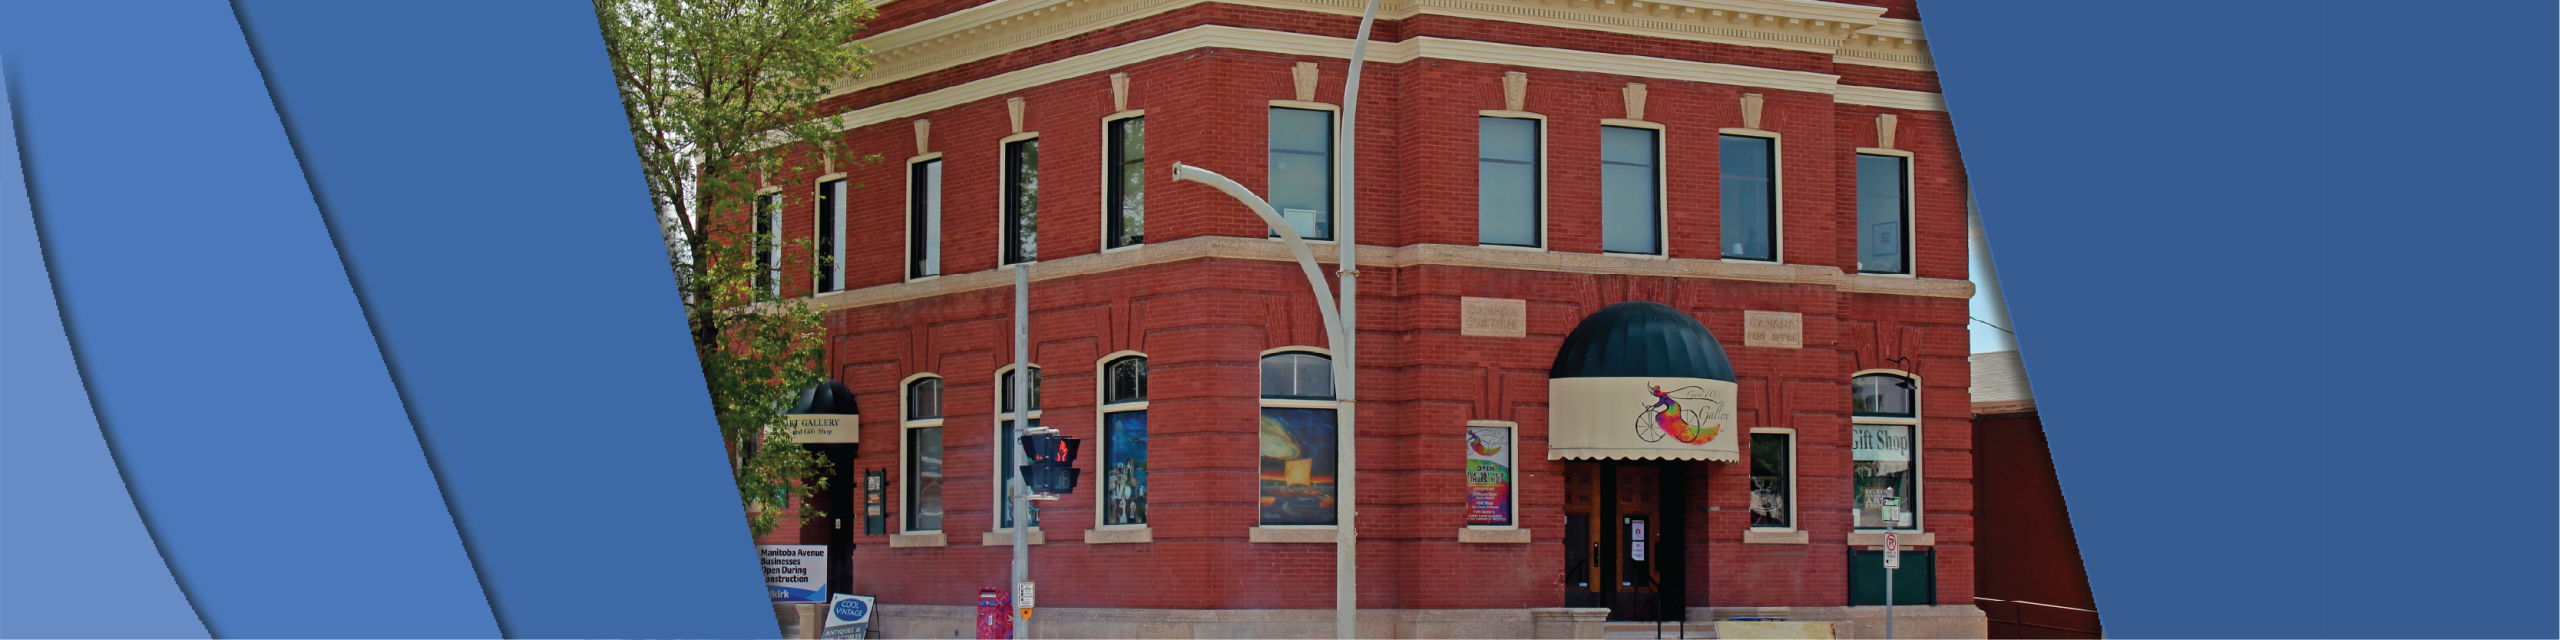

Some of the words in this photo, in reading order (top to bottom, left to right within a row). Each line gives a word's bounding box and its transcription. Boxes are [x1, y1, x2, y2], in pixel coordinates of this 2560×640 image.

[1750, 316, 1795, 328] CANADA
[802, 419, 839, 427] GALLERY
[1852, 428, 1873, 450] Gift
[1877, 429, 1908, 456] Shop
[760, 557, 801, 565] Businesses
[761, 566, 780, 575] Open
[781, 566, 807, 575] During
[765, 575, 809, 583] onstruction
[769, 589, 789, 598] lkirk
[841, 600, 859, 609] COOL
[836, 607, 863, 617] VINTAGE
[825, 627, 854, 636] ANTIQUES
